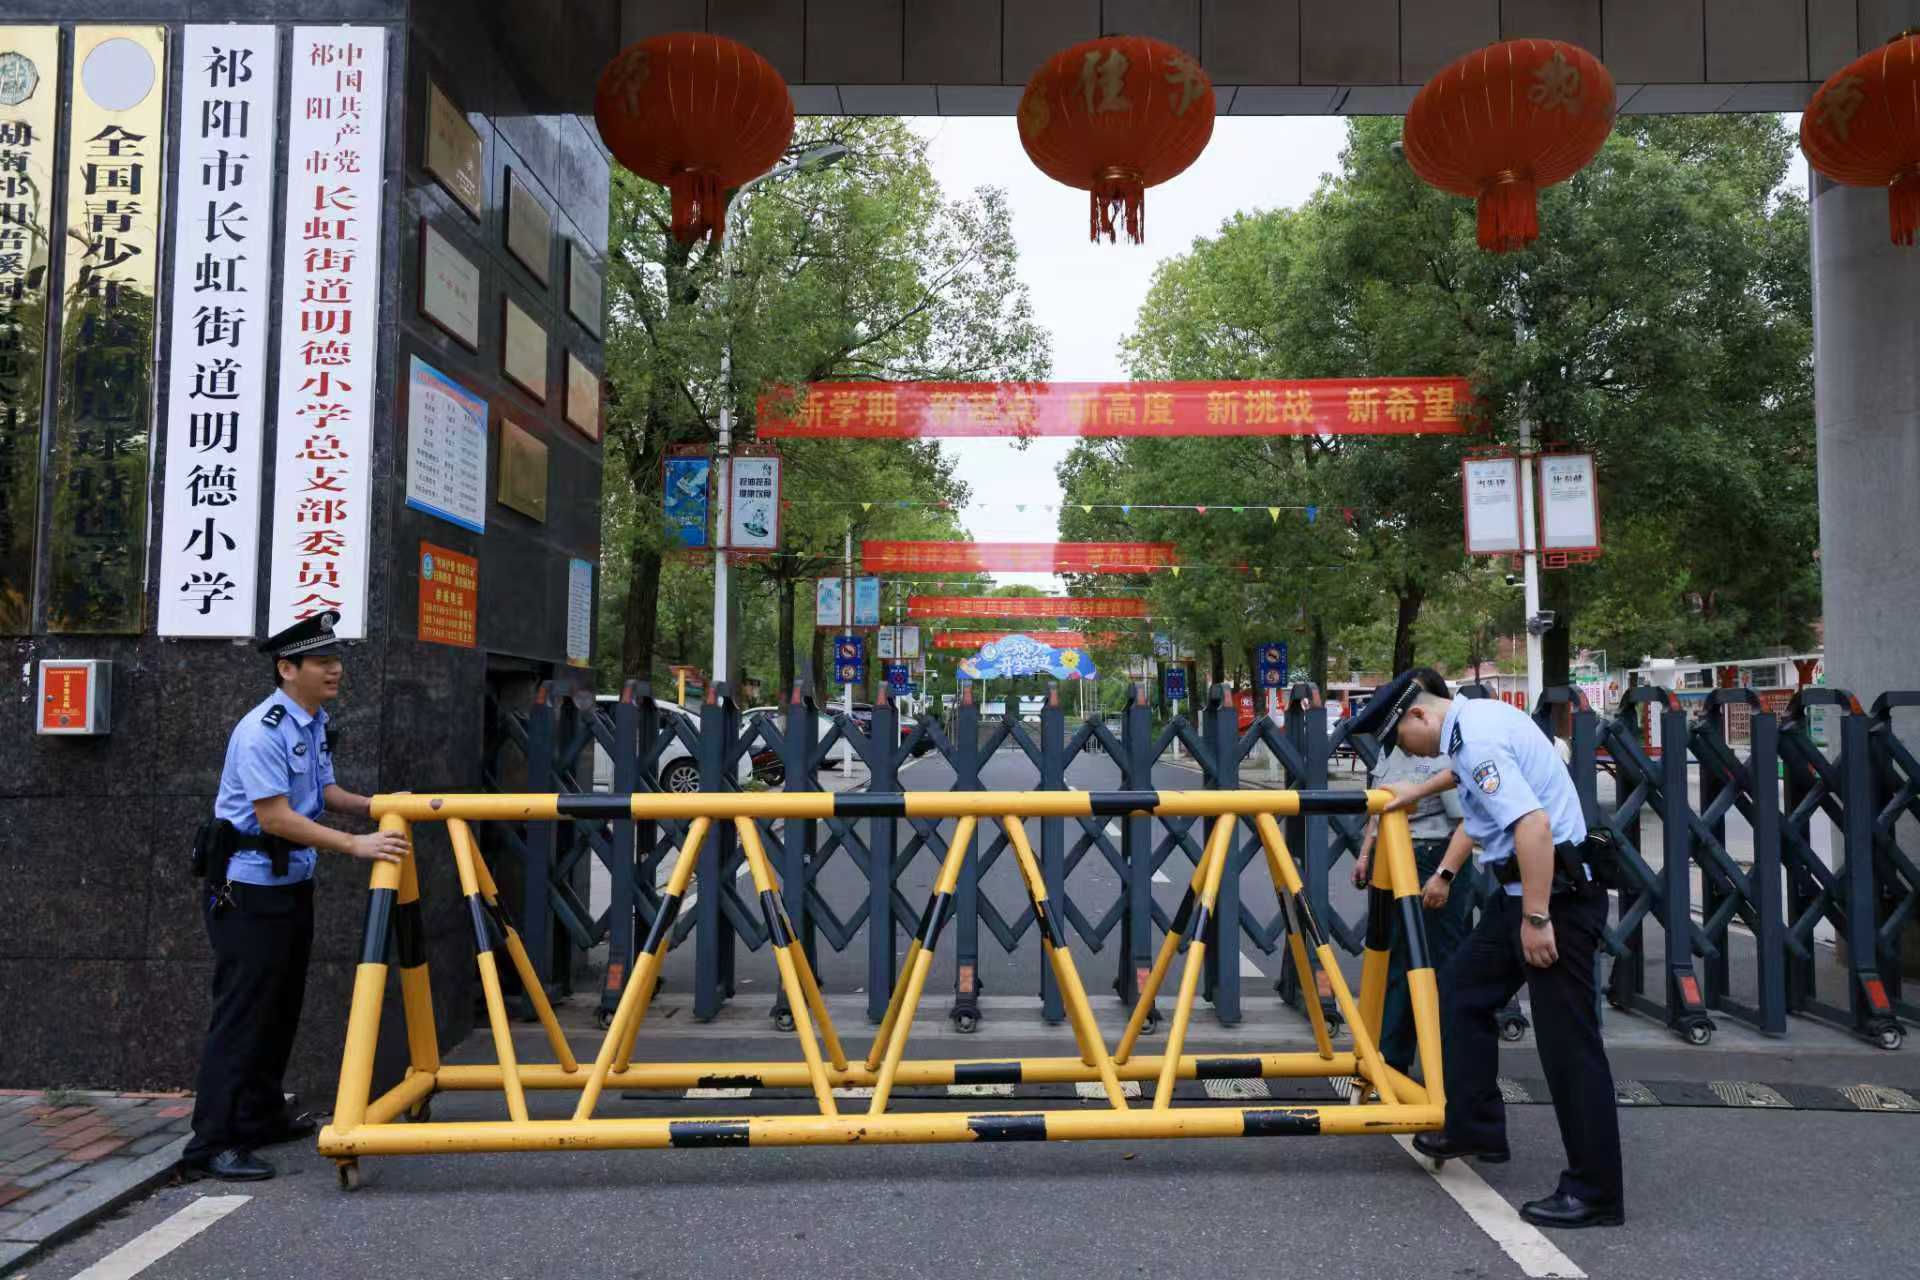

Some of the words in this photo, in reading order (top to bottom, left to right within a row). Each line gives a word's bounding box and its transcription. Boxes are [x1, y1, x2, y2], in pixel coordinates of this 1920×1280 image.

[306, 43, 334, 174] 祁阳市
[333, 43, 363, 174] 中国共产党
[180, 47, 253, 615] 祁阳市长虹街道明德小学
[796, 391, 897, 427] 新学期
[1207, 389, 1316, 425] 新挑战
[1346, 386, 1457, 424] 新希望
